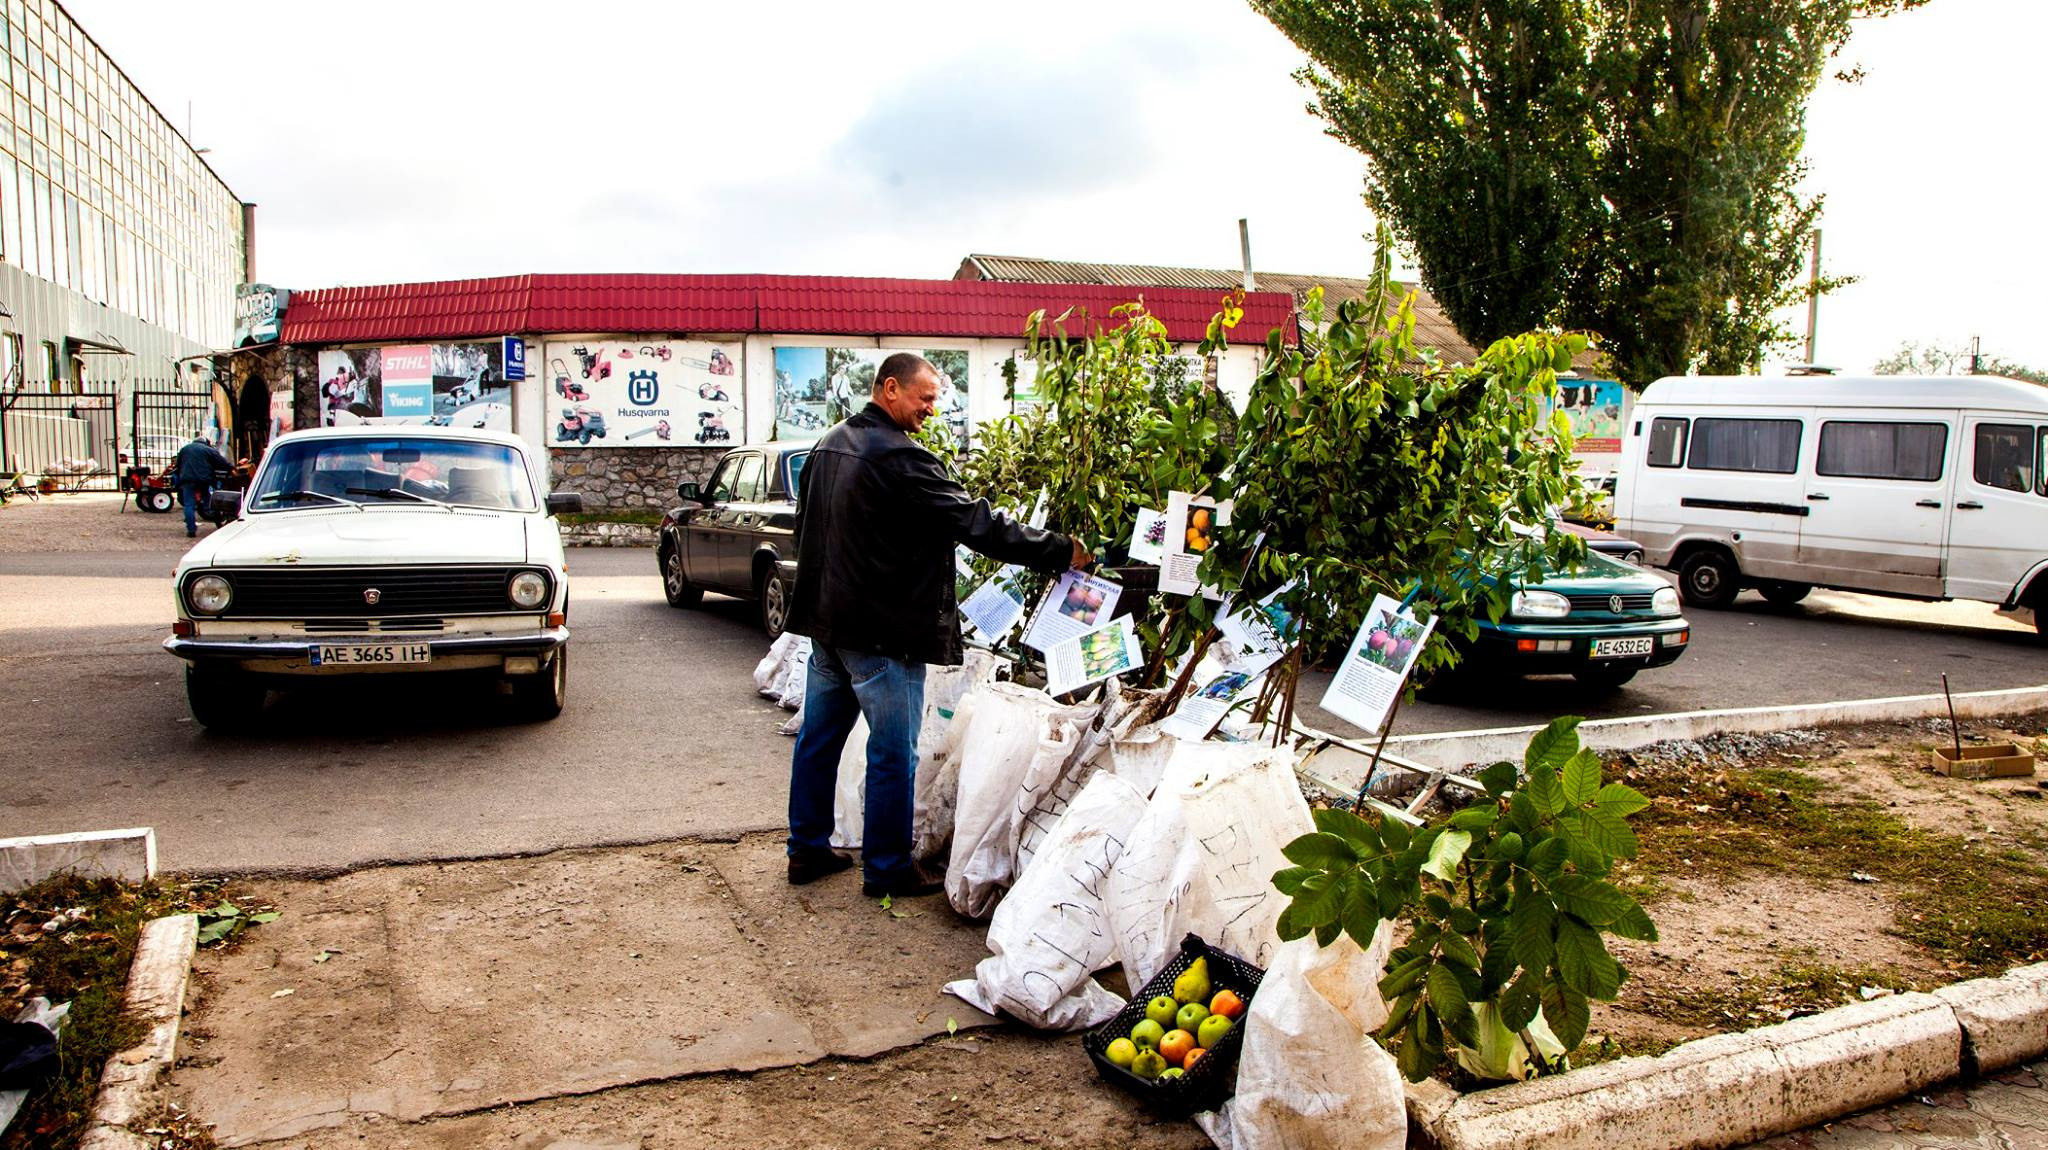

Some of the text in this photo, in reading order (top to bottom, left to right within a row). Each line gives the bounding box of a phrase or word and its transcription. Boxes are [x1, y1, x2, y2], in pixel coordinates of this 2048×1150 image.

[386, 356, 426, 370] STIHL
[389, 393, 424, 407] VIKING
[617, 408, 670, 418] Husqvarna
[323, 648, 348, 662] AE
[353, 646, 394, 662] 3665
[1596, 639, 1651, 655] AE 4532 EC
